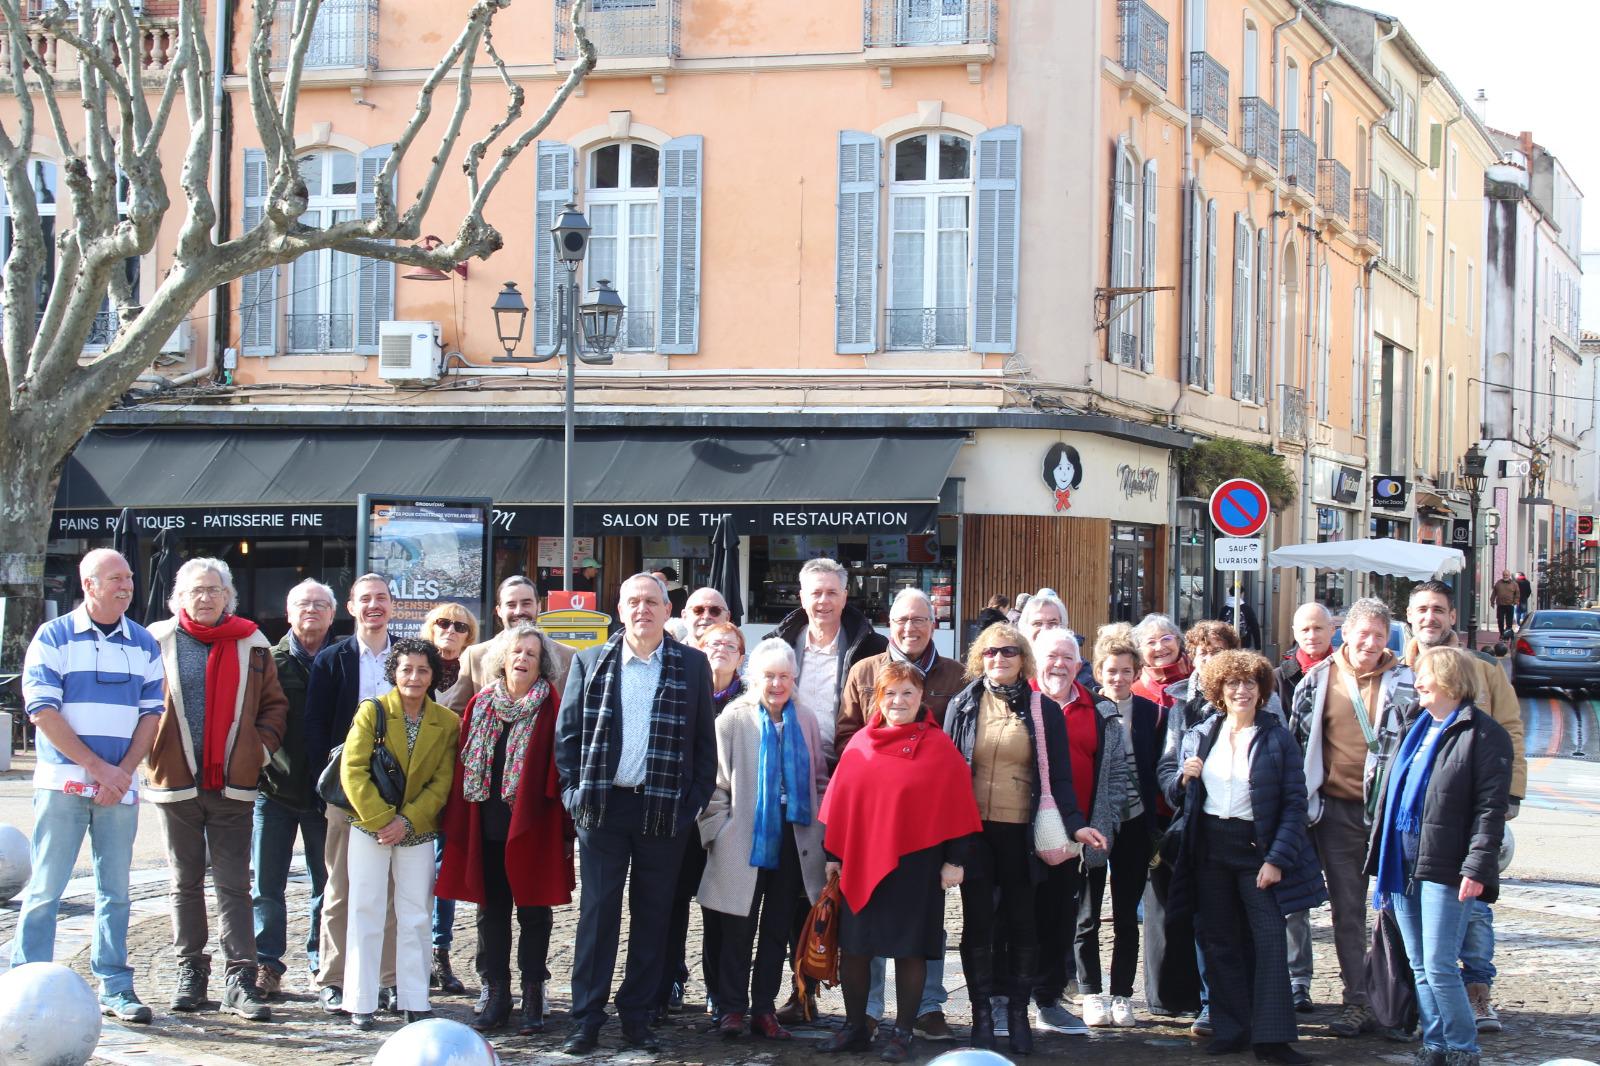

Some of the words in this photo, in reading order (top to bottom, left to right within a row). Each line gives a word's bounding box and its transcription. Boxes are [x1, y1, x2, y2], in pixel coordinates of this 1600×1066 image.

[59, 517, 99, 531] PAINS
[105, 515, 185, 529] RTIQUES
[203, 513, 284, 528] PATISSERIE
[291, 513, 323, 526] FINE
[602, 513, 658, 527] SALON
[667, 513, 690, 527] DE
[699, 513, 732, 527] TH
[773, 511, 908, 526] RESTAURATION
[388, 574, 440, 600] ALÈS
[391, 610, 424, 620] POPUL
